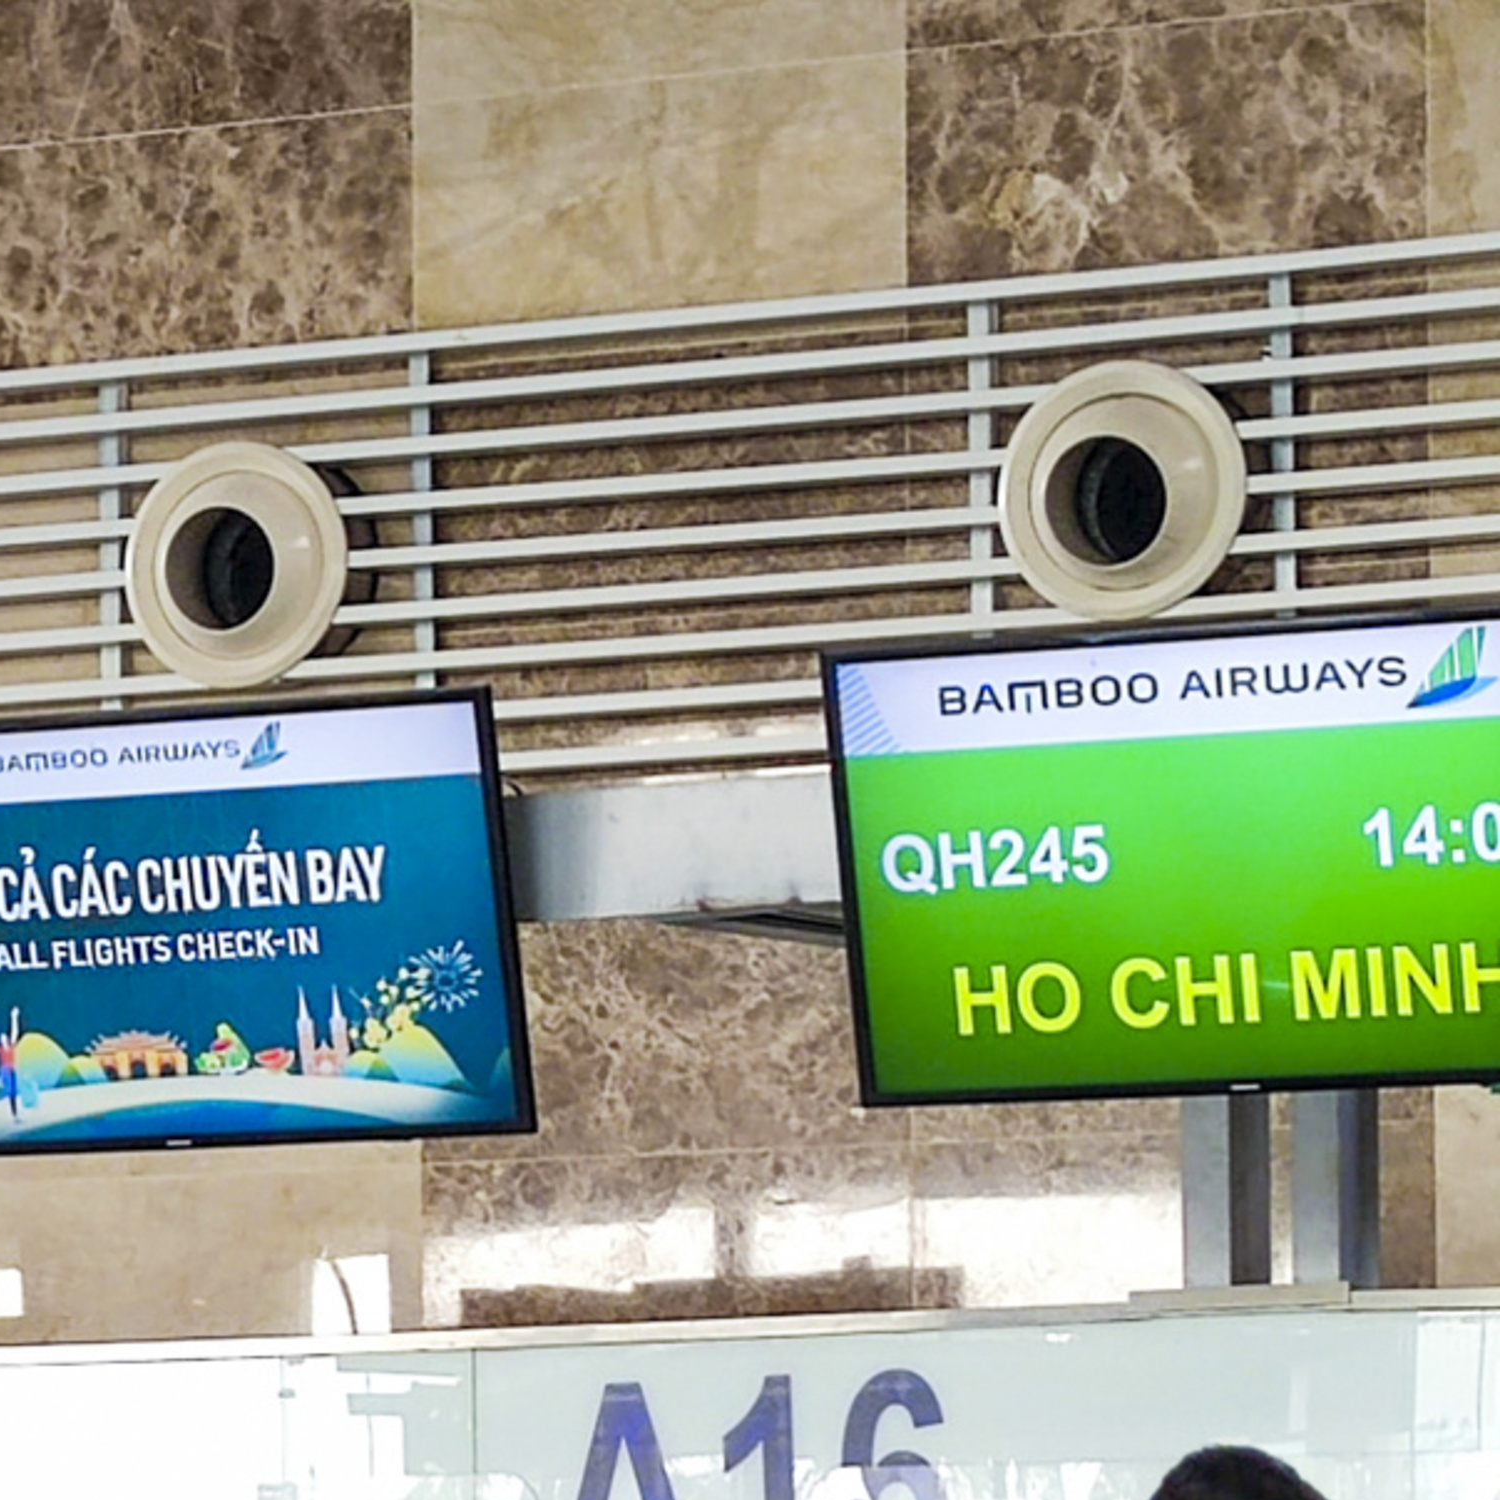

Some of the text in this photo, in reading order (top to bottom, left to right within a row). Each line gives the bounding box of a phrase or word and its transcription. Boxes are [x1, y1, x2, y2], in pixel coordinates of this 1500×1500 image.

[938, 656, 1408, 716] BAMBOO AIRWAYS
[118, 739, 241, 764] AIRWAYS
[51, 846, 130, 918] CÁC
[137, 828, 301, 914] CHUYẾN
[305, 845, 386, 904] BAY
[881, 824, 1111, 895] QH245
[51, 933, 172, 969] FLIGHTS
[176, 926, 320, 961] CHECK-IN
[953, 961, 1082, 1036] HO
[1109, 953, 1263, 1028] CHI
